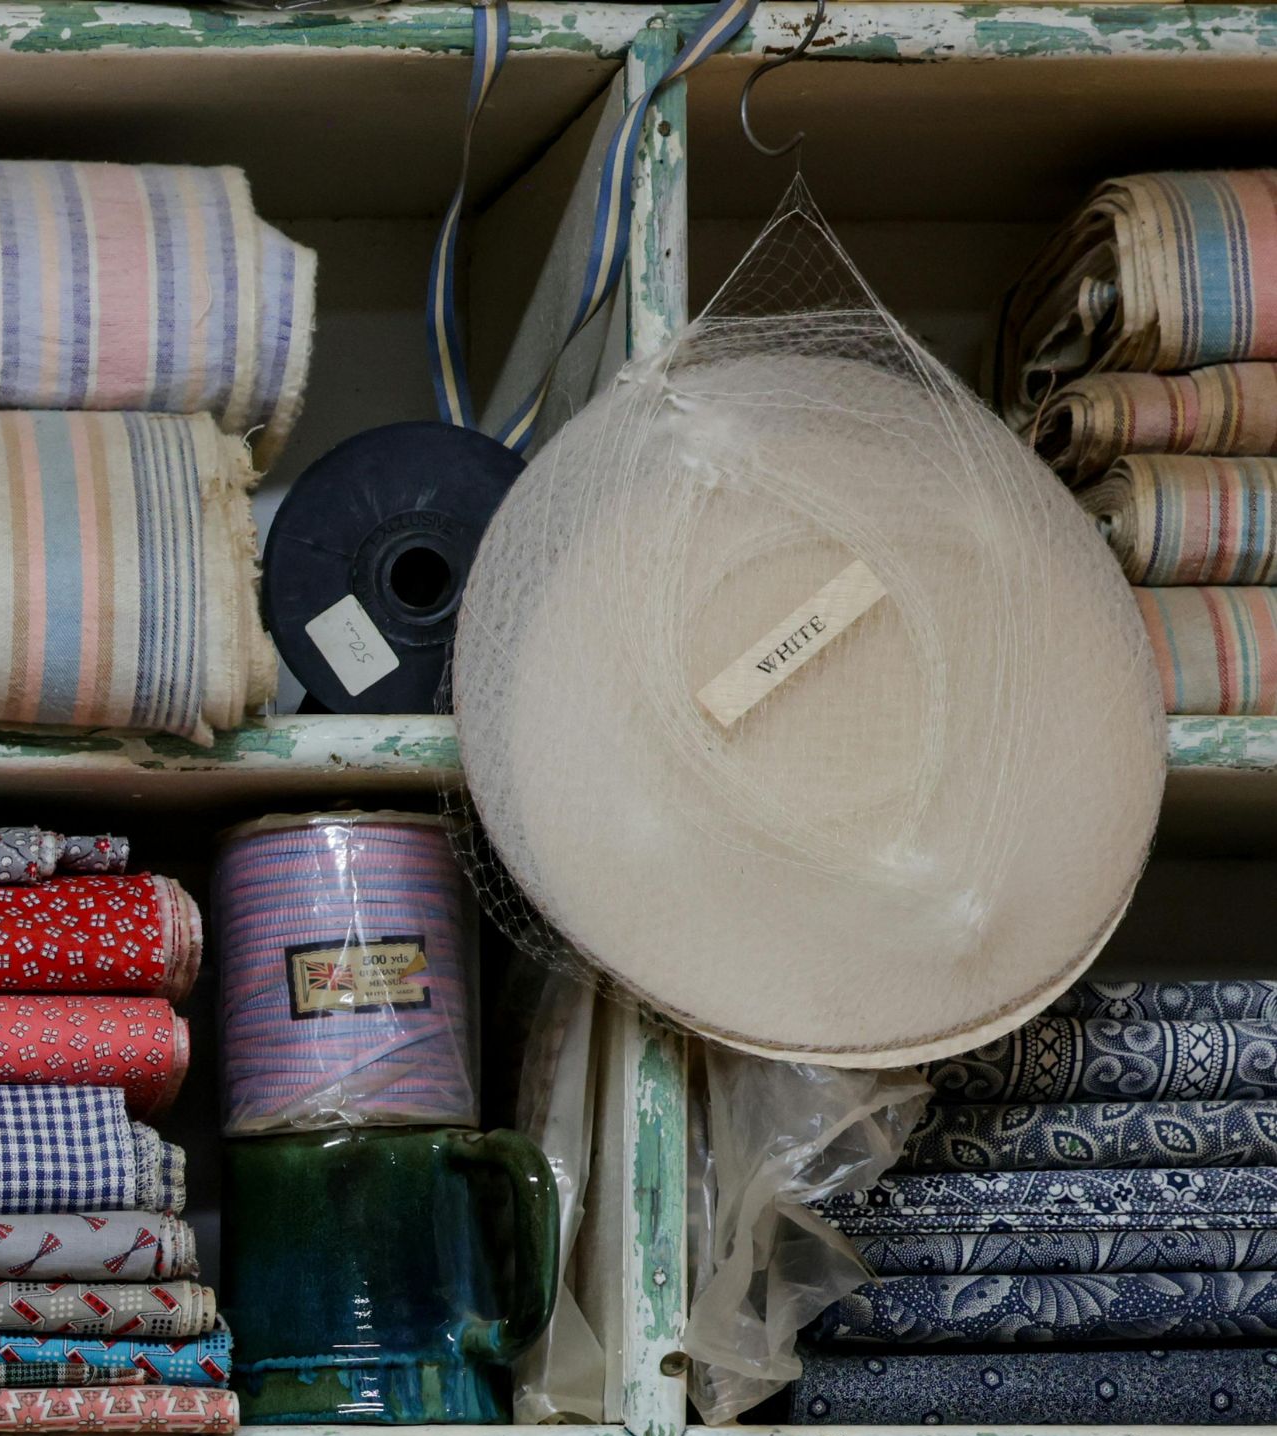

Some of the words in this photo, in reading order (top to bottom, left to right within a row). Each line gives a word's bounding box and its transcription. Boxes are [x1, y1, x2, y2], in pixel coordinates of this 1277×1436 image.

[755, 615, 827, 676] WHITE
[362, 954, 387, 966] 500
[391, 953, 409, 965] yds
